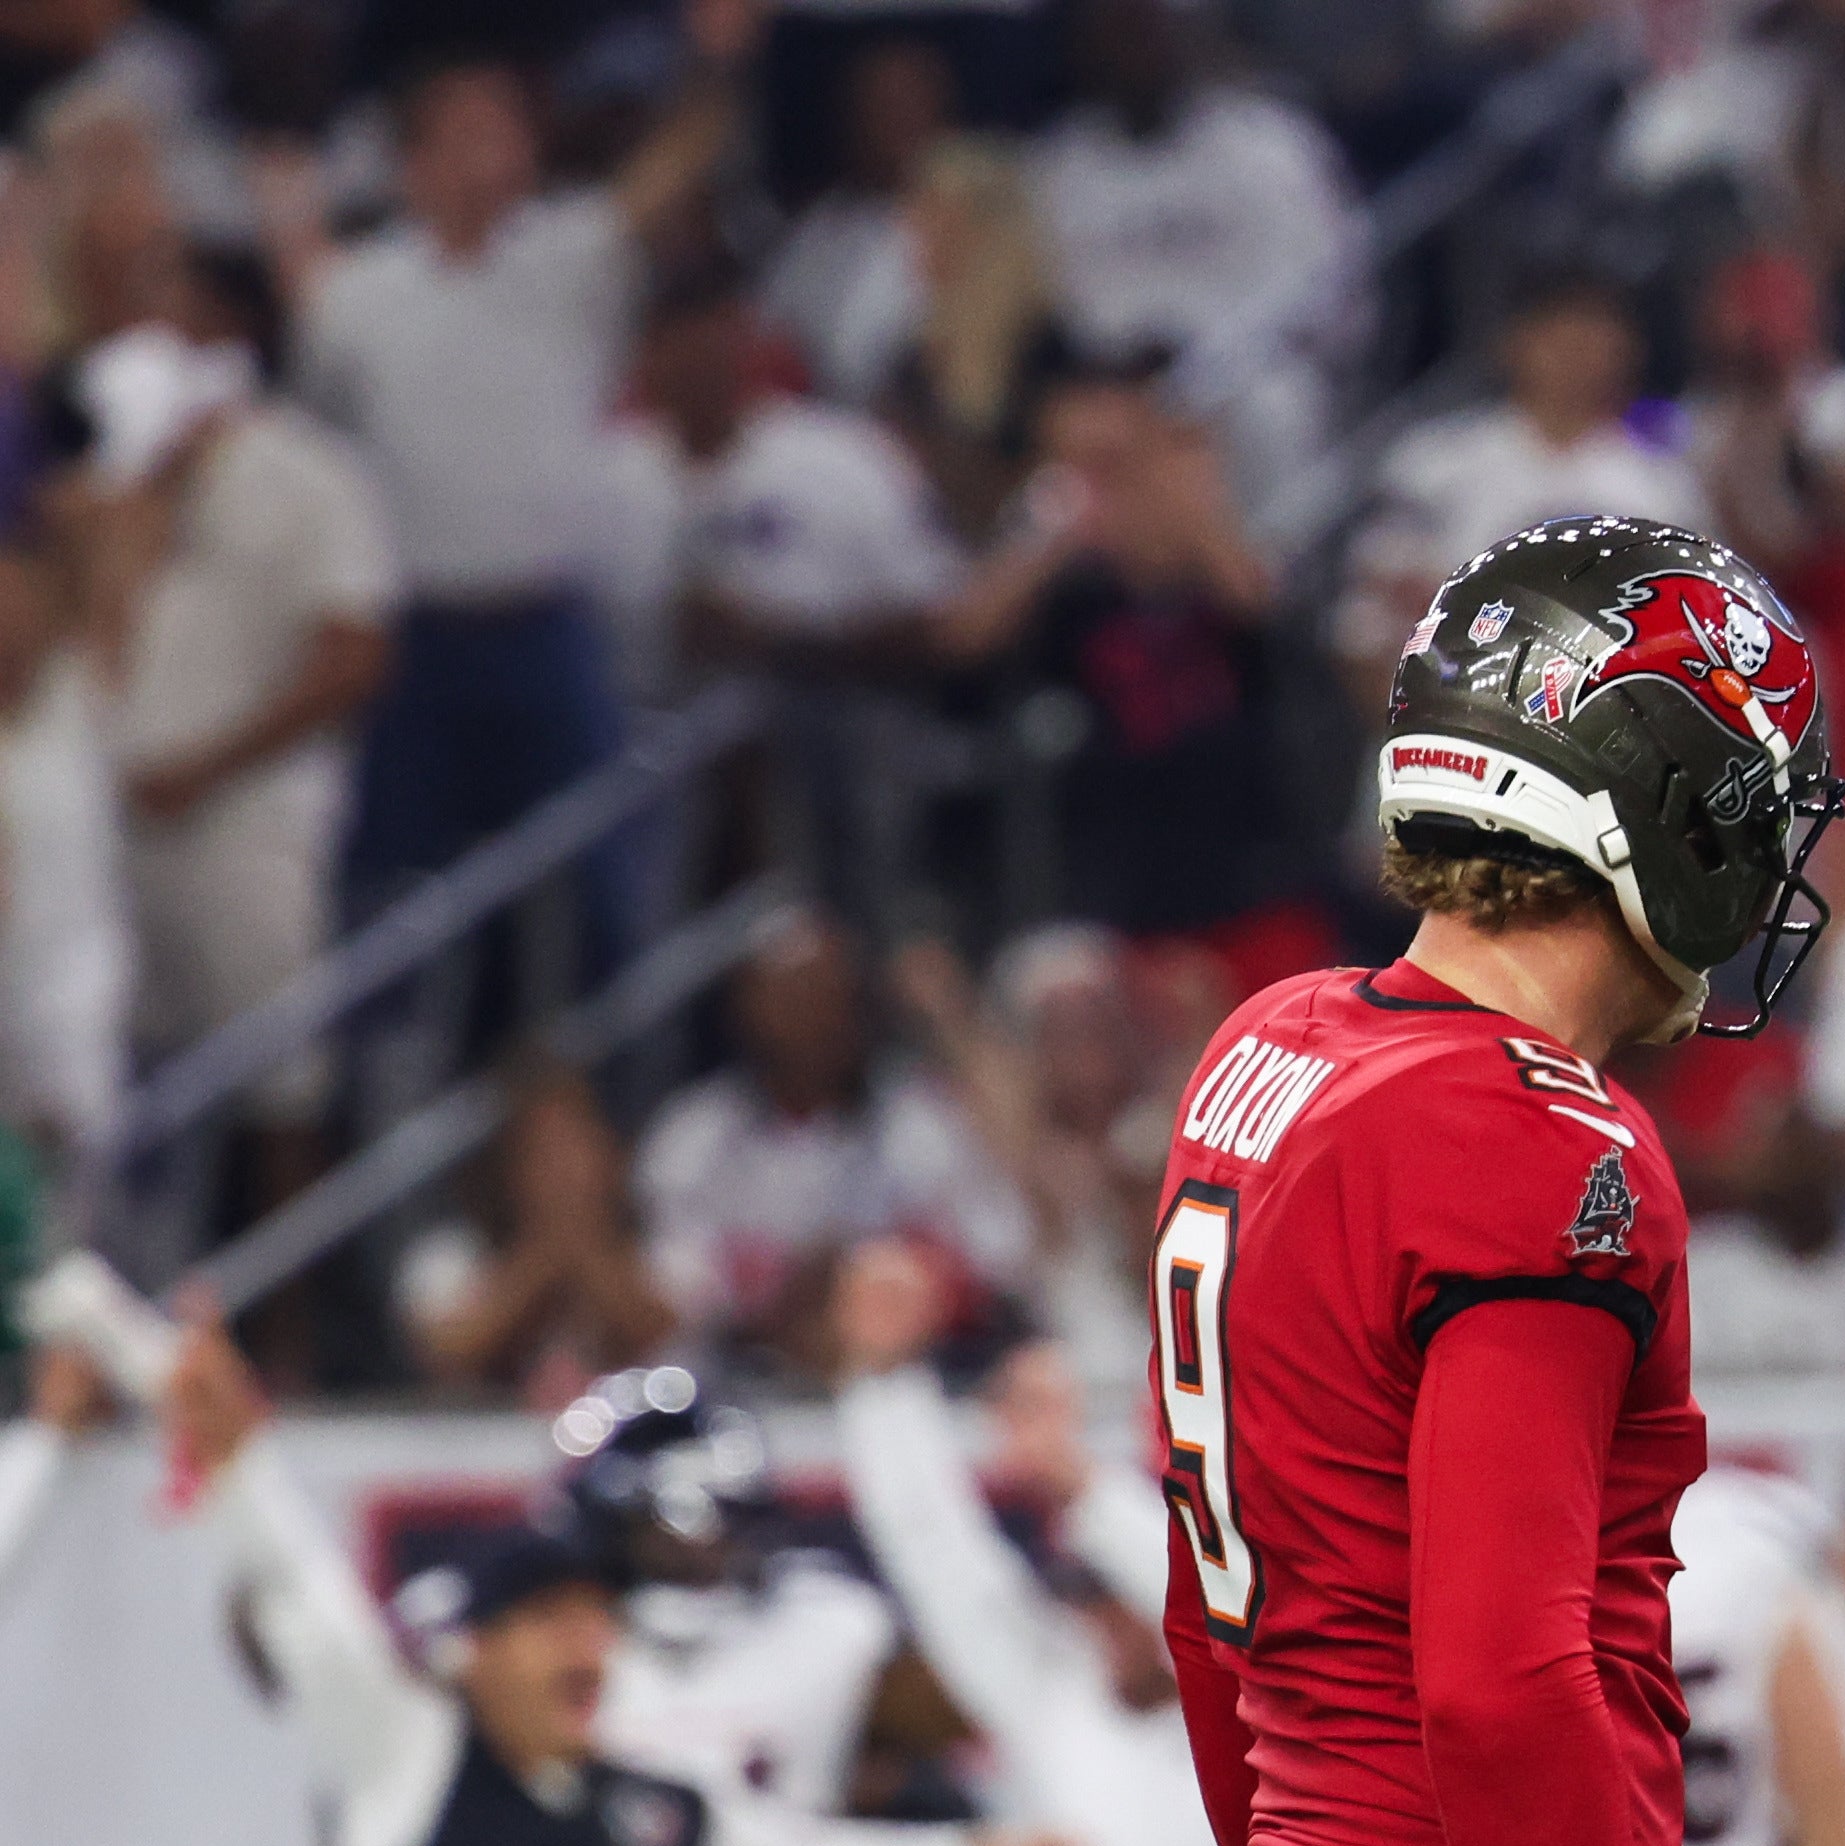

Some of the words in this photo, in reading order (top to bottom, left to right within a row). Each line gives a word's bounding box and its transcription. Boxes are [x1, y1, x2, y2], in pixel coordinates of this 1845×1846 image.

[1392, 747, 1489, 782] BUCCANEERS
[1182, 1034, 1336, 1164] DIXON
[1496, 1036, 1621, 1112] 9
[1155, 1178, 1267, 1648] 9
